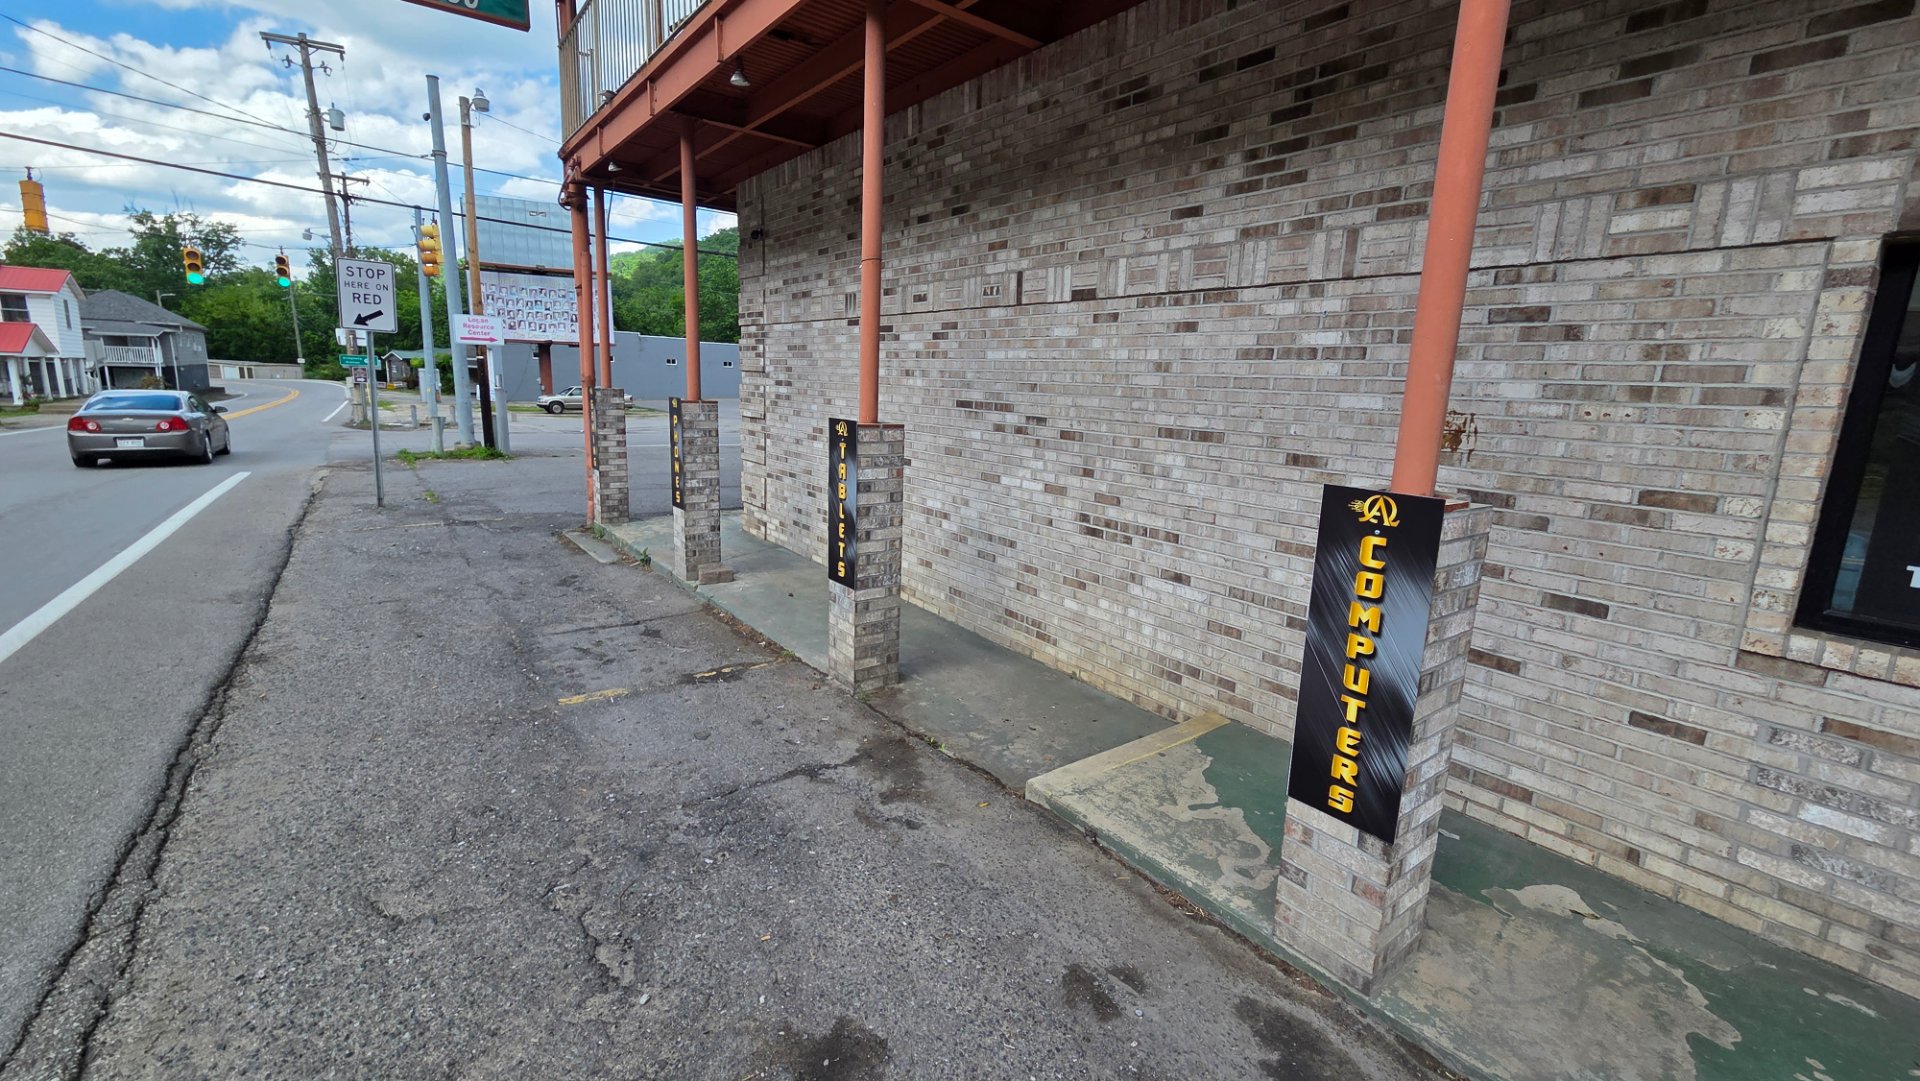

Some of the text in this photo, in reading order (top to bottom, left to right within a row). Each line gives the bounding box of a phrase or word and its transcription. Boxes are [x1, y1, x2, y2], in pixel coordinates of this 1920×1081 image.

[346, 265, 386, 280] STOP
[344, 280, 389, 292] HERE ON
[352, 292, 382, 305] RED
[463, 322, 495, 330] Resource
[837, 442, 848, 578] TABLETS
[1327, 535, 1388, 814] COMPUTERS
